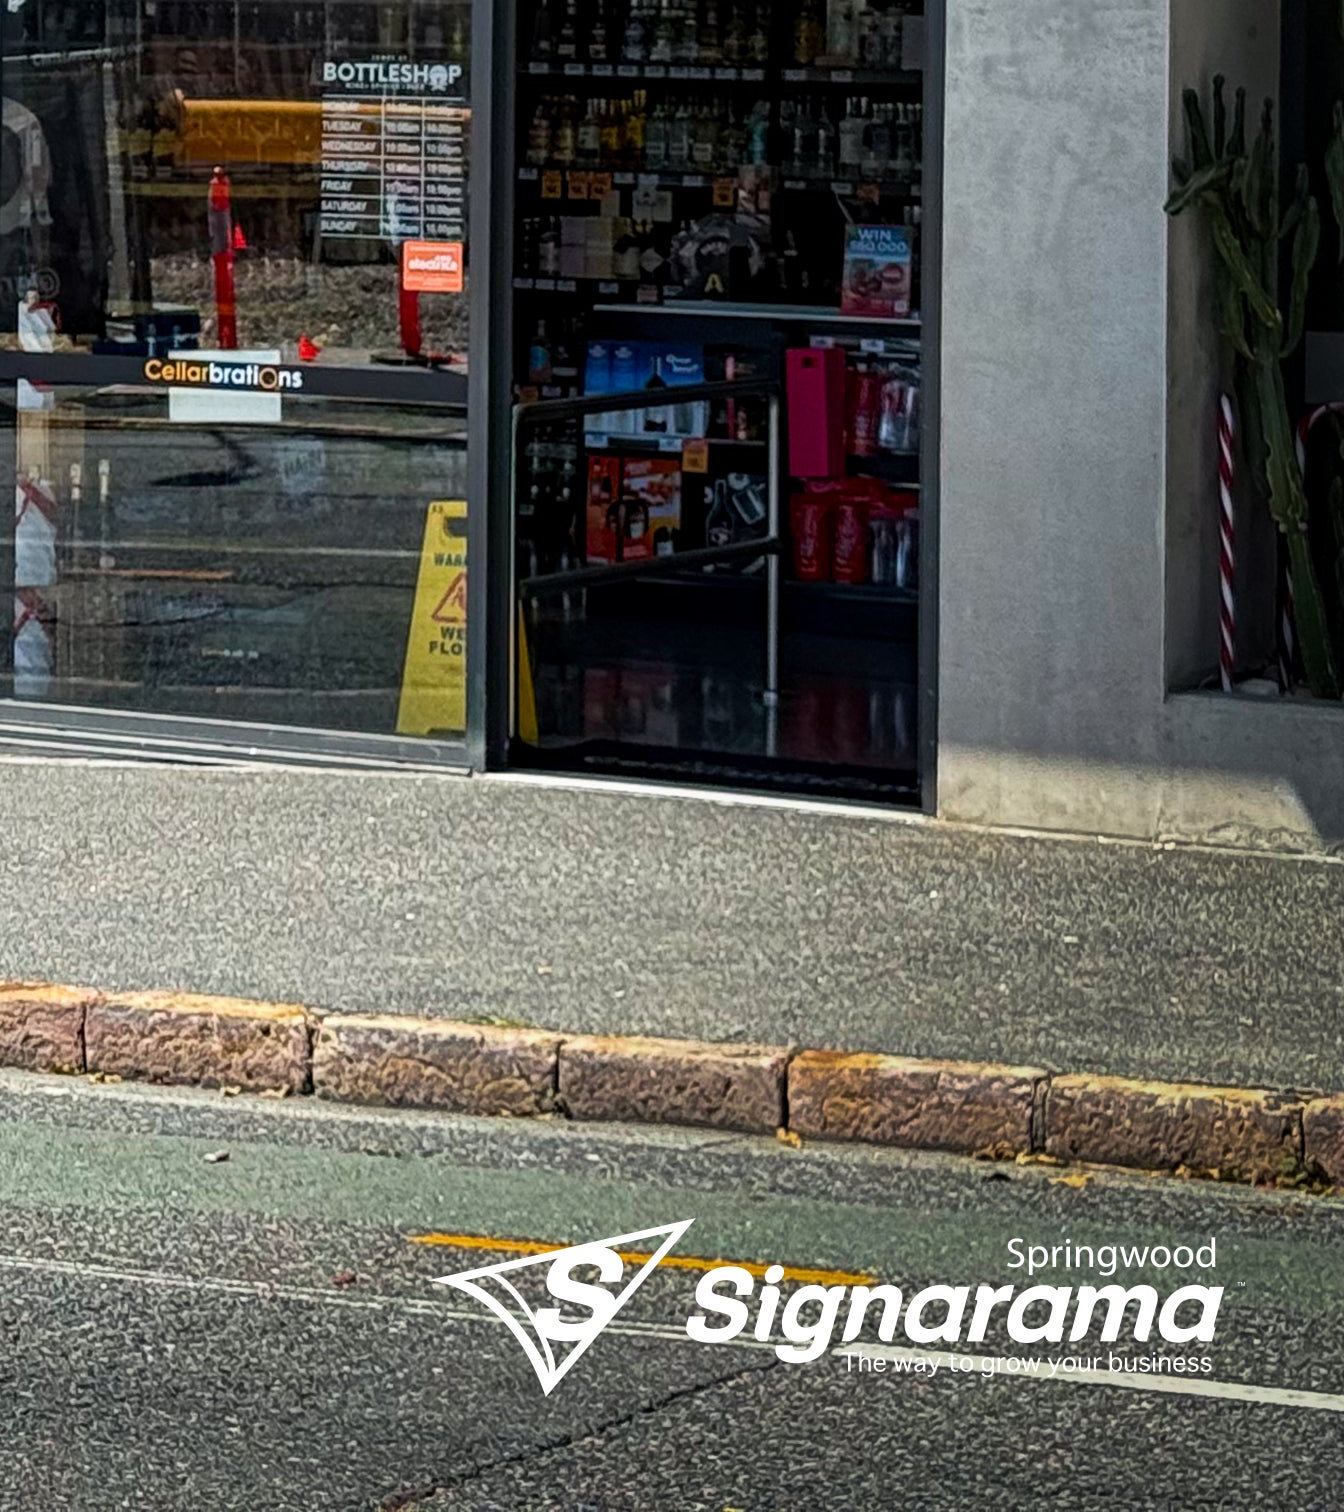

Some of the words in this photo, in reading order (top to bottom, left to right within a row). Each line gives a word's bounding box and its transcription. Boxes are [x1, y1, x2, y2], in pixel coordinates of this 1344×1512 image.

[324, 62, 461, 89] BOTTLESHOP
[323, 122, 361, 131] TUESDAY
[322, 141, 376, 152] WEDNESDAY
[322, 181, 352, 191] FRIDAY
[321, 201, 366, 211] SATURDAY
[321, 221, 357, 231] SUNDAY
[858, 228, 891, 241] WIN
[145, 359, 303, 389] Cellarbrations
[434, 551, 468, 567] WAR
[440, 626, 467, 640] WE
[429, 641, 464, 655] FLO
